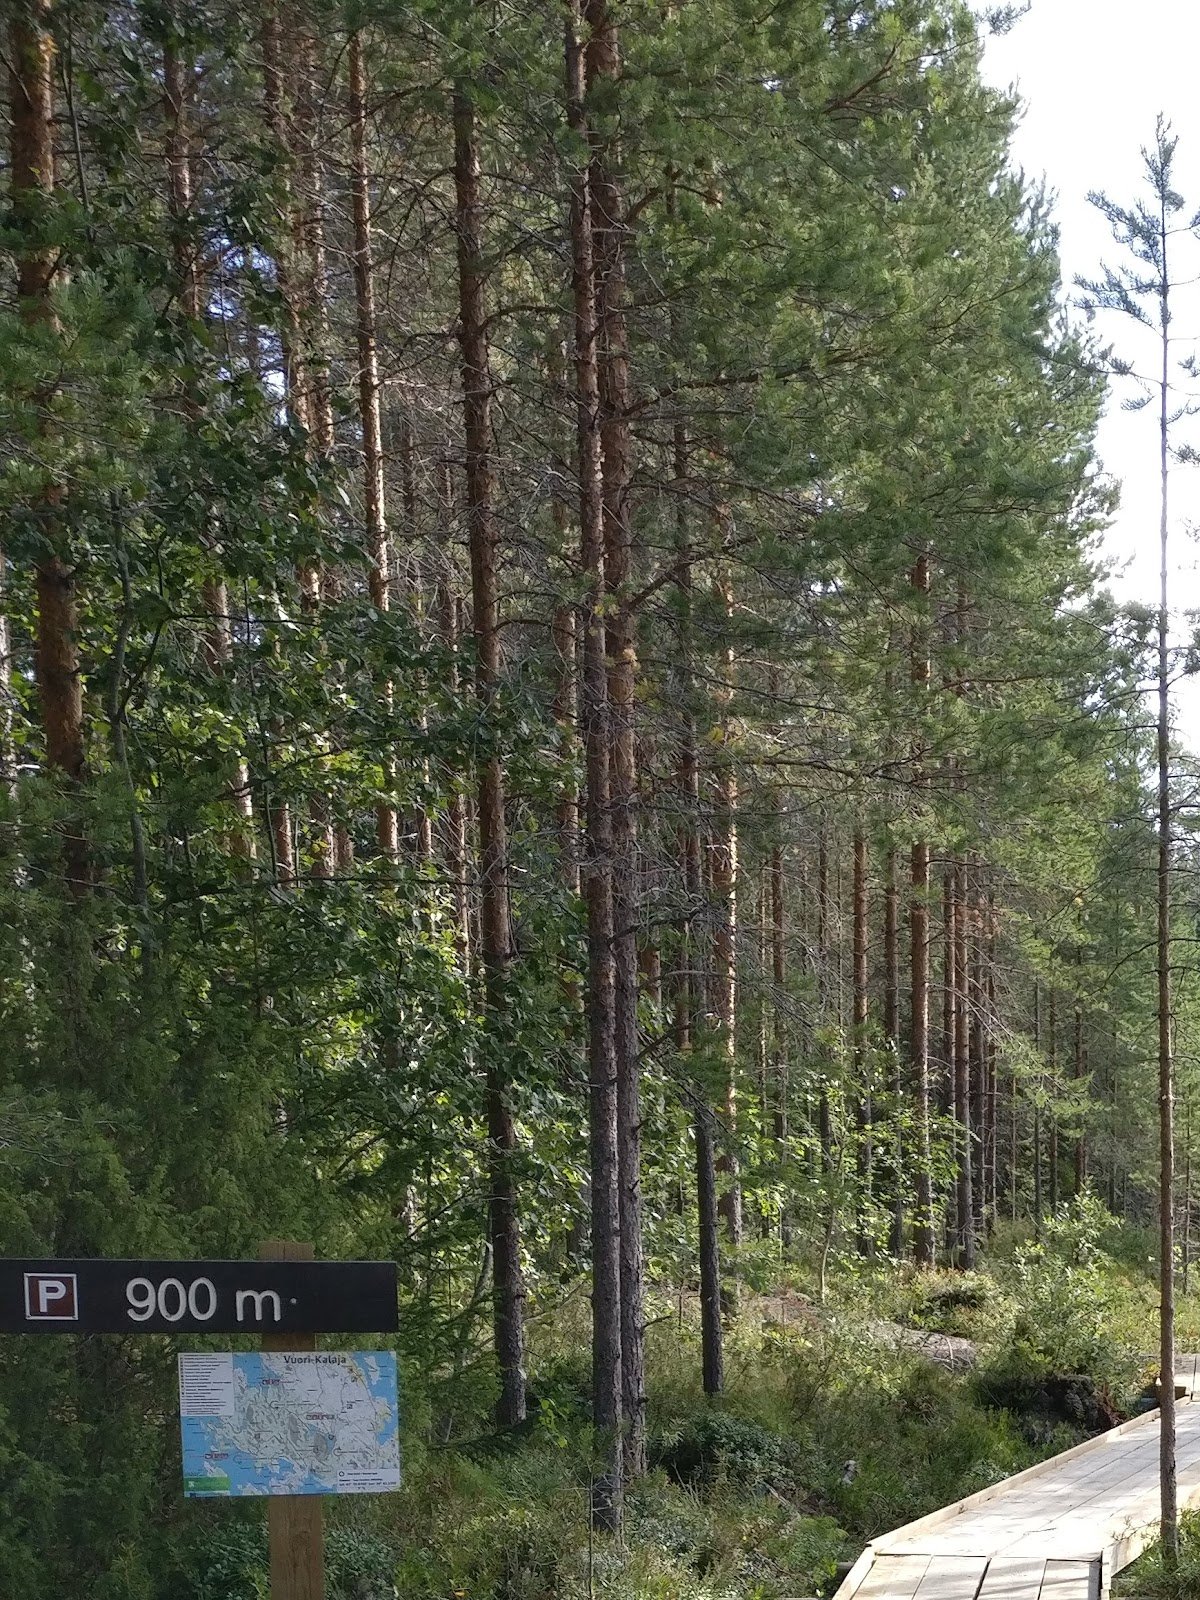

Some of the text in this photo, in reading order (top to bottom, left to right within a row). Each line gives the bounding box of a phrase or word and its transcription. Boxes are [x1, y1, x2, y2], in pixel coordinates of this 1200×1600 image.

[39, 1280, 66, 1313] P
[125, 1277, 217, 1322] 900
[283, 1354, 347, 1366] Vuori-Kalaja
